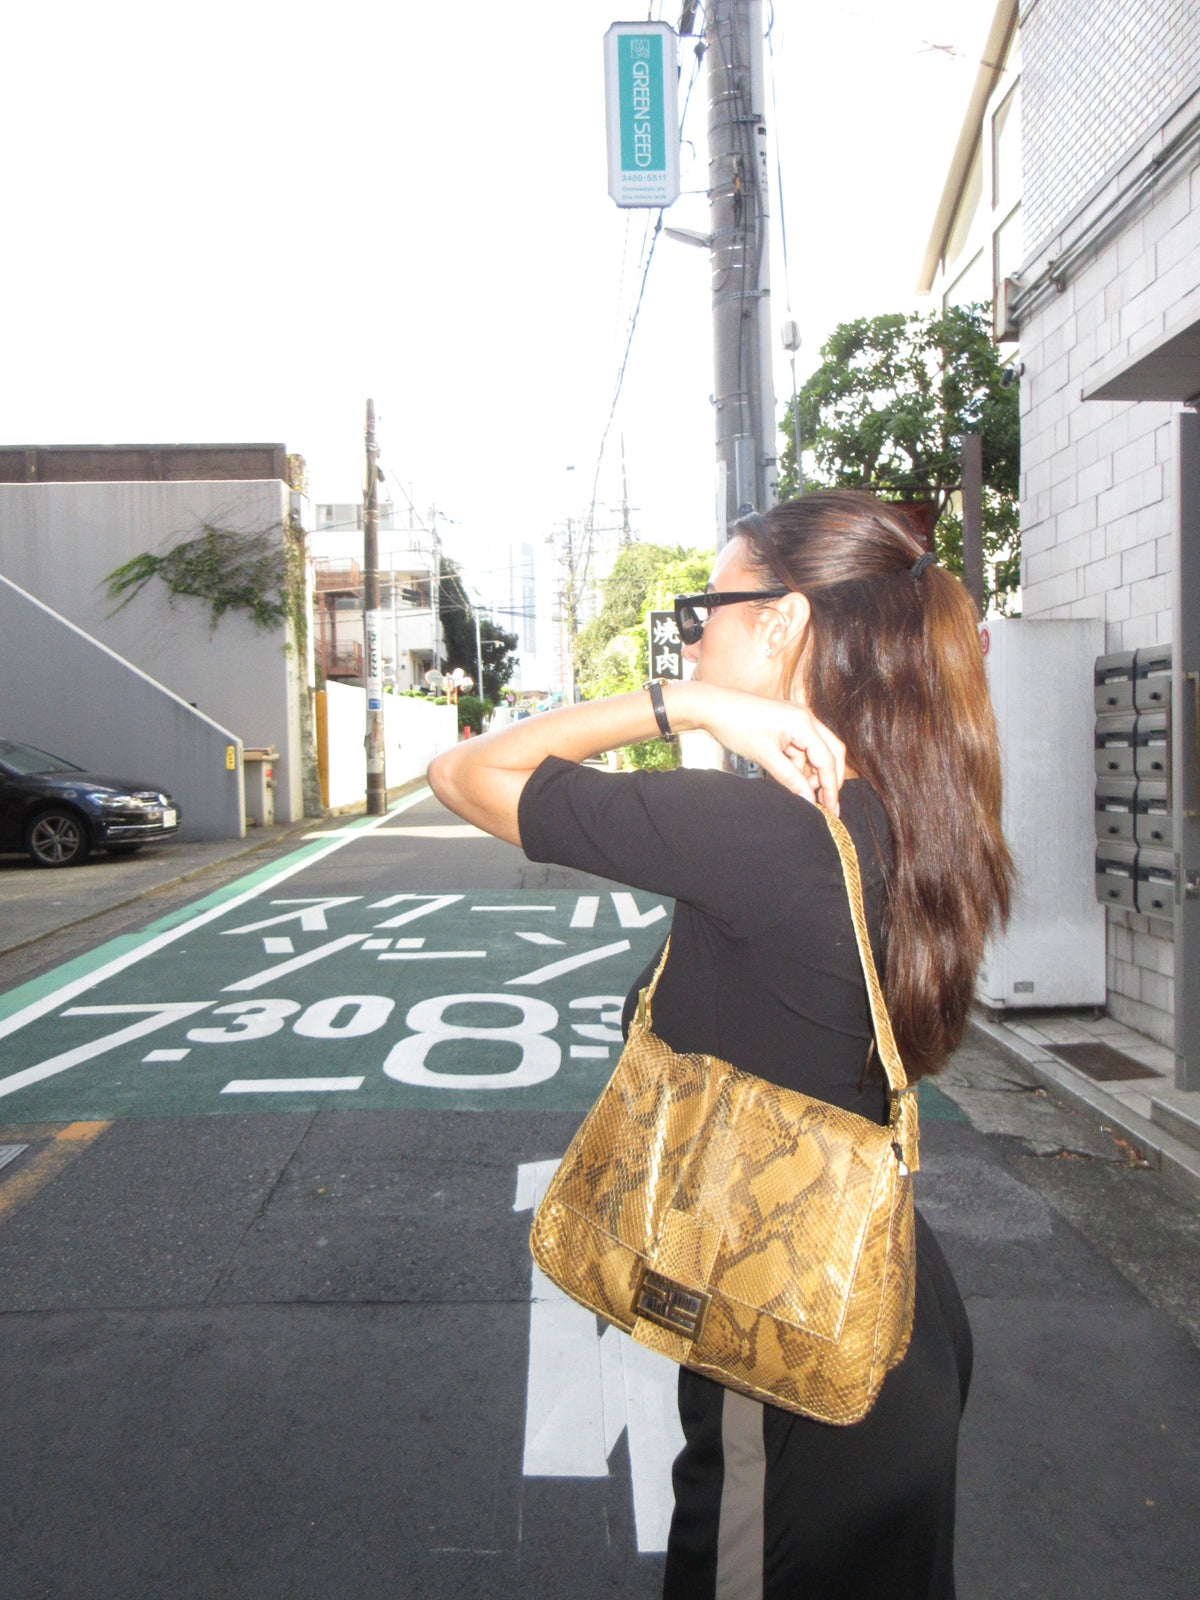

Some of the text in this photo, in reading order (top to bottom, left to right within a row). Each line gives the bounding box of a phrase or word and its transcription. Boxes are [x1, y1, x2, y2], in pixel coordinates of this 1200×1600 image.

[633, 61, 650, 119] GREEN
[634, 122, 652, 168] SEED
[653, 616, 681, 677] 焼肉
[219, 892, 668, 935] スクール
[219, 933, 632, 992] ゾーン
